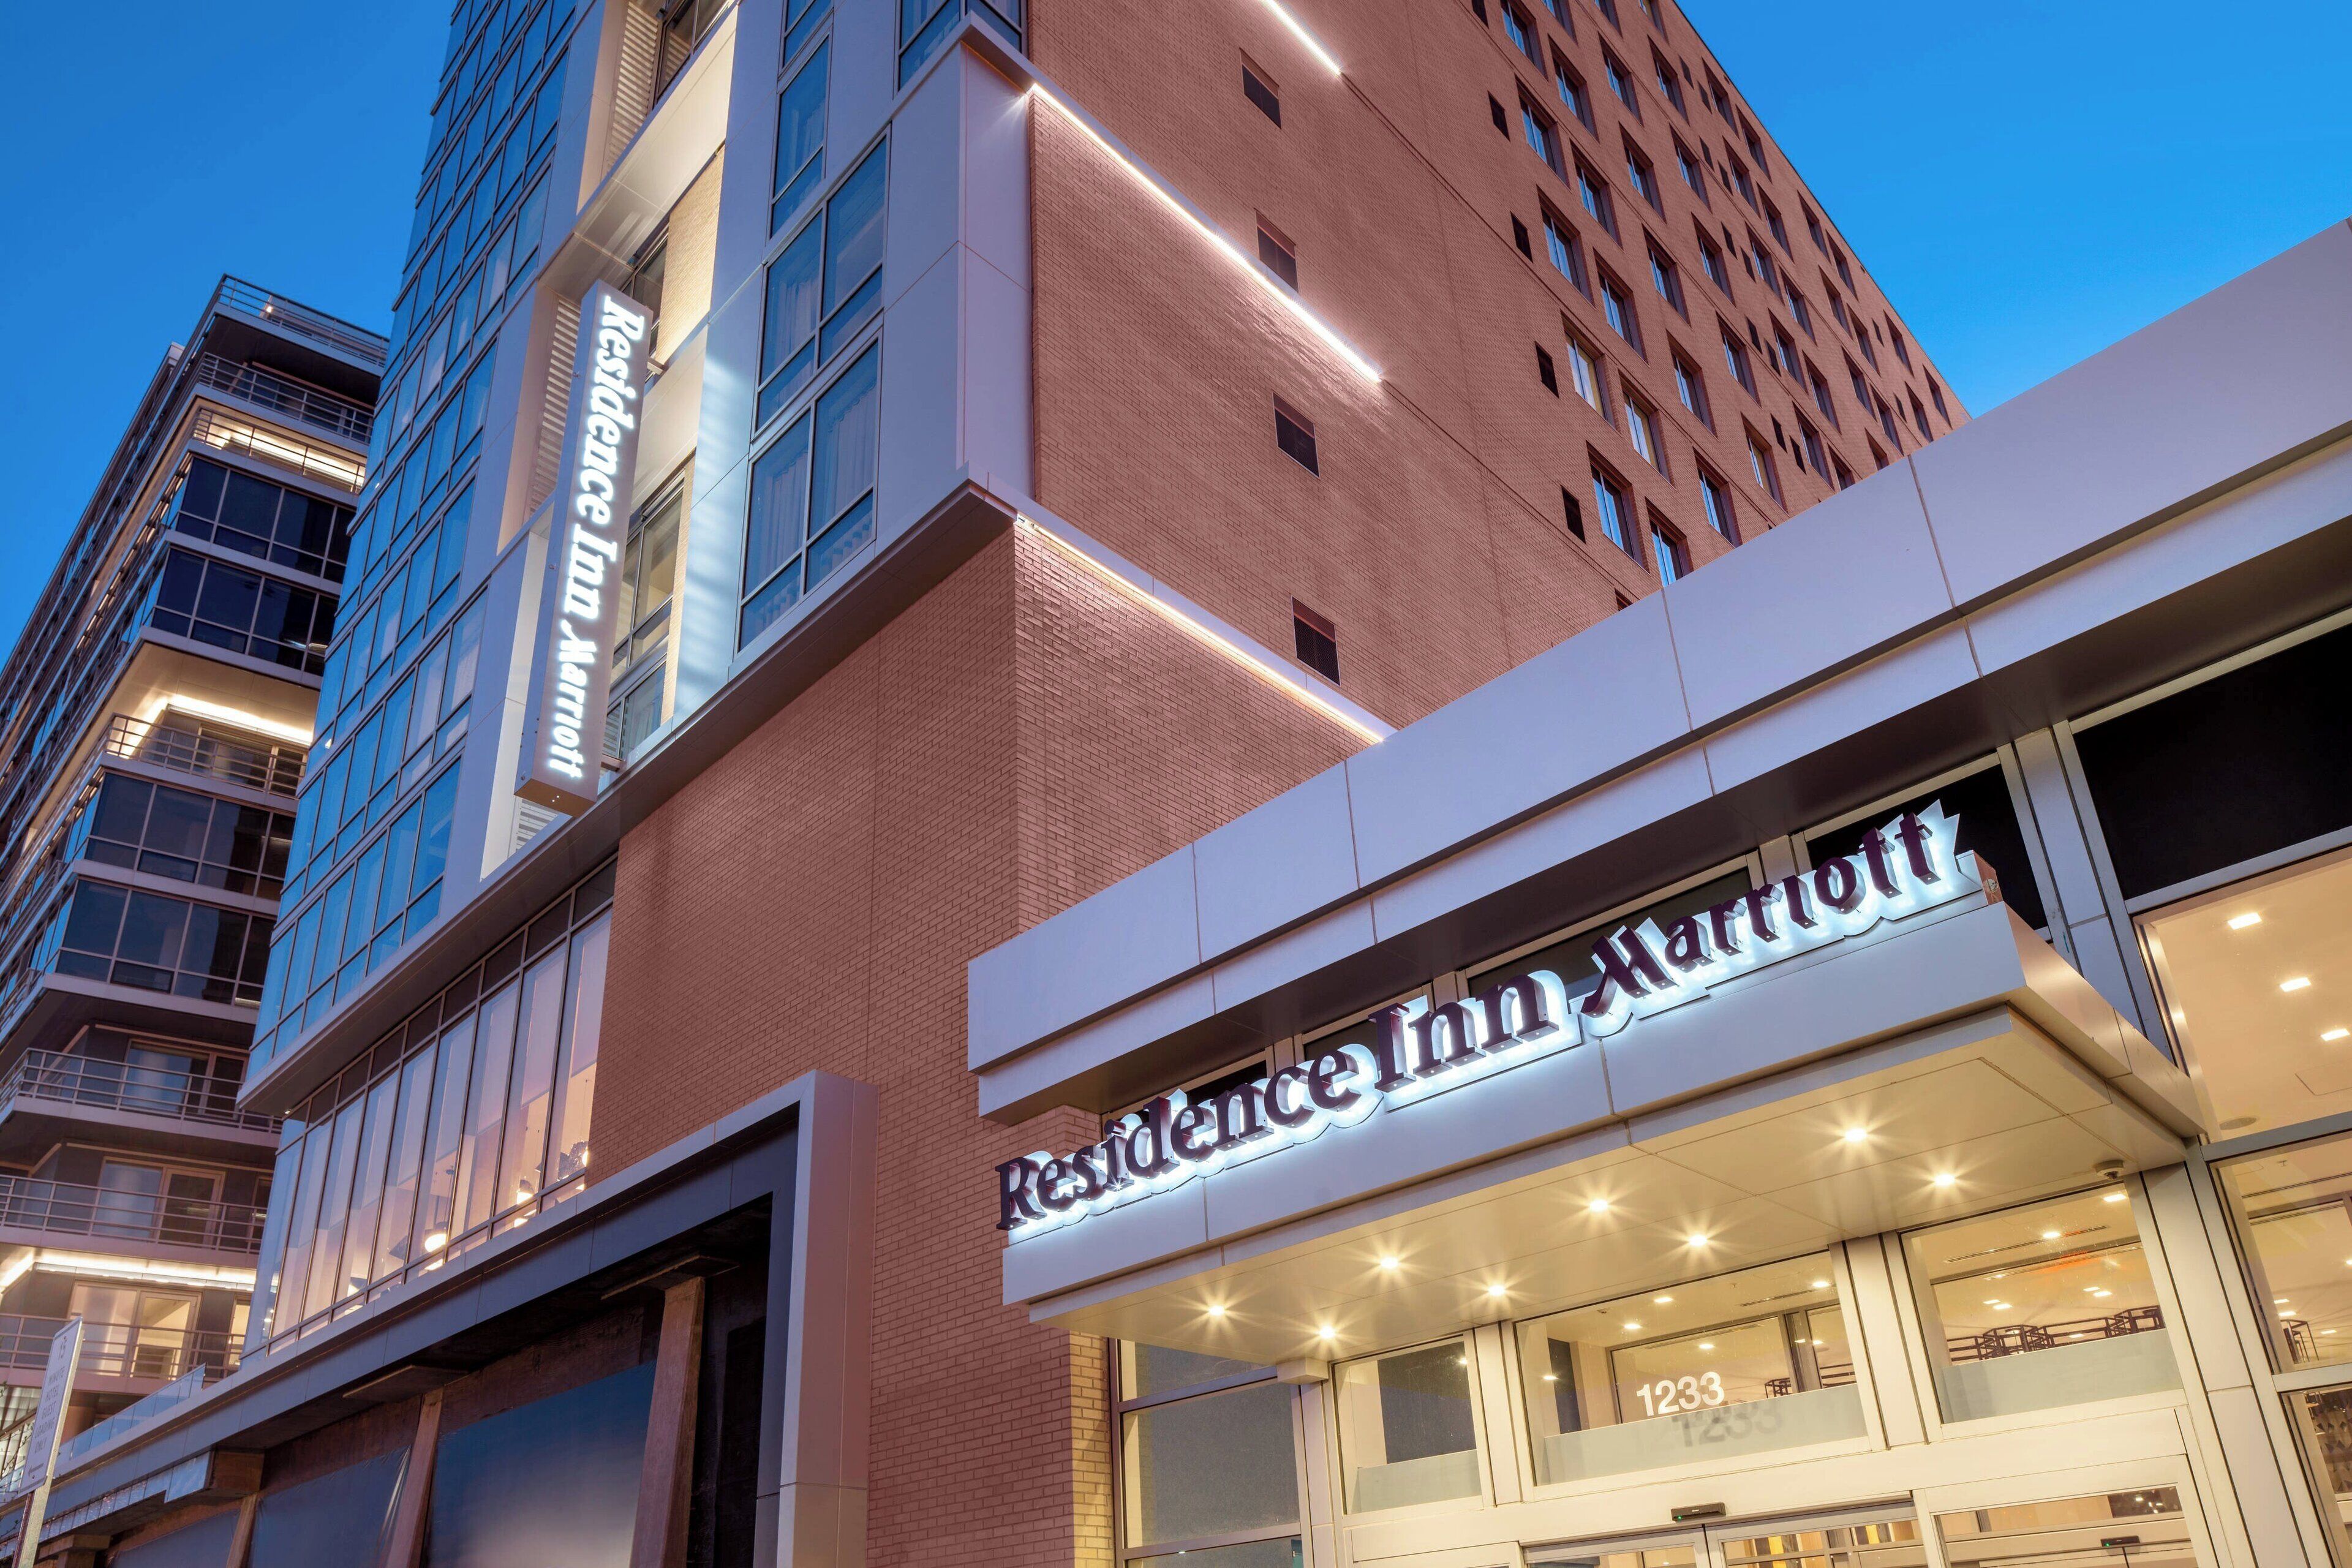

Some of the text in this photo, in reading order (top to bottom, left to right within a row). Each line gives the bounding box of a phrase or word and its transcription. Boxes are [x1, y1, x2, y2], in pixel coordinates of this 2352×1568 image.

[549, 295, 645, 779] Residence Inn Marriott
[995, 812, 1940, 1231] Residence Inn Marriott
[58, 1338, 67, 1360] 15
[45, 1384, 59, 1401] HOTEL
[1636, 1371, 1725, 1417] 1233
[41, 1401, 56, 1419] GUEST
